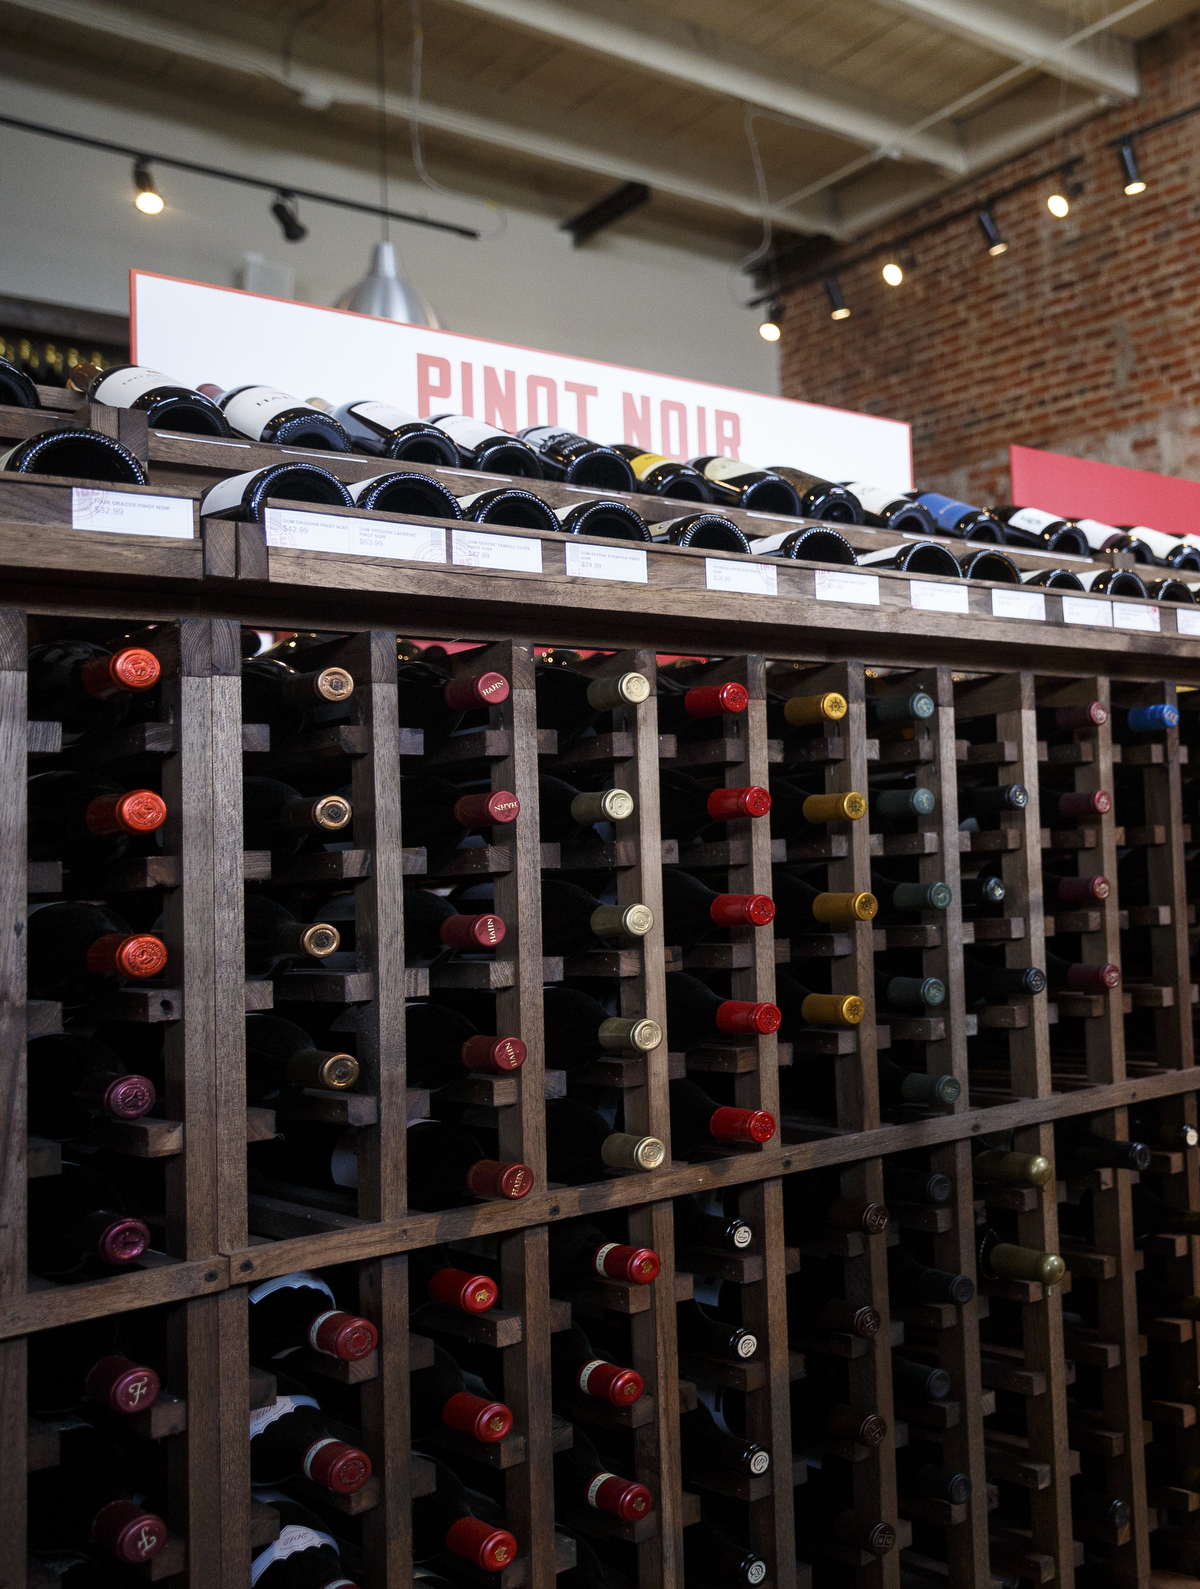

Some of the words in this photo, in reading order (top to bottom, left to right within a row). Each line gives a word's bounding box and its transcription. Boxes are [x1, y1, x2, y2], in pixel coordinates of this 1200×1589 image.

[416, 352, 598, 438] PINOT
[622, 390, 742, 464] NOIR
[94, 506, 124, 516] $32.99
[111, 500, 137, 508] GRACES
[137, 502, 156, 510] PINOT
[282, 524, 309, 535] $42.99
[295, 519, 320, 528] DROUHIN
[370, 527, 393, 535] DROUHIN
[393, 530, 417, 538] LAURENE
[359, 538, 384, 547] $63.99
[496, 542, 516, 550] YAMHILL
[580, 561, 602, 570] $74.99
[481, 679, 505, 697] HAHN
[494, 801, 518, 813] HAHN
[486, 917, 498, 944] HAHN
[504, 1041, 518, 1068] HAHN
[511, 1169, 526, 1197] HAHN
[128, 1376, 148, 1407] F
[137, 1526, 157, 1557] F
[283, 1531, 309, 1547] 2012
